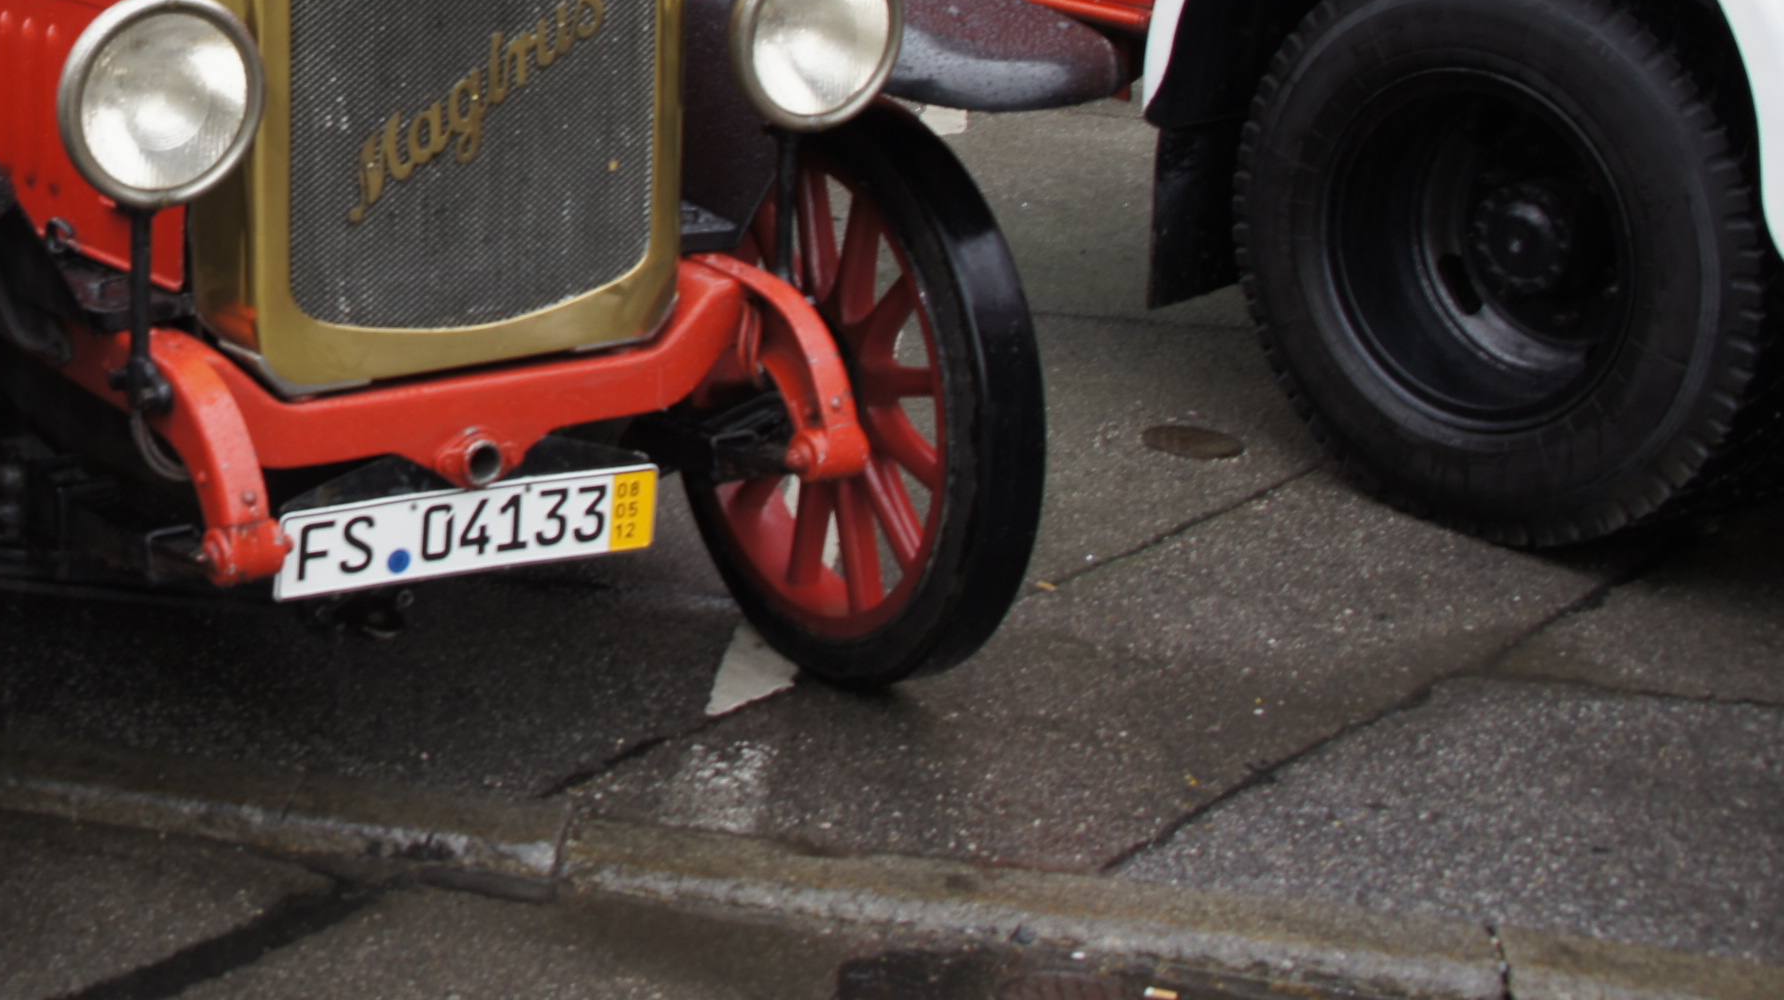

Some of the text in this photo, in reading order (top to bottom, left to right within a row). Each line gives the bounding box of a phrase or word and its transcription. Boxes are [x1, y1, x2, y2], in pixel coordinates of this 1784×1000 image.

[616, 481, 639, 498] 08
[615, 501, 638, 519] 05
[298, 485, 607, 581] FS 04133
[615, 522, 635, 539] 12
